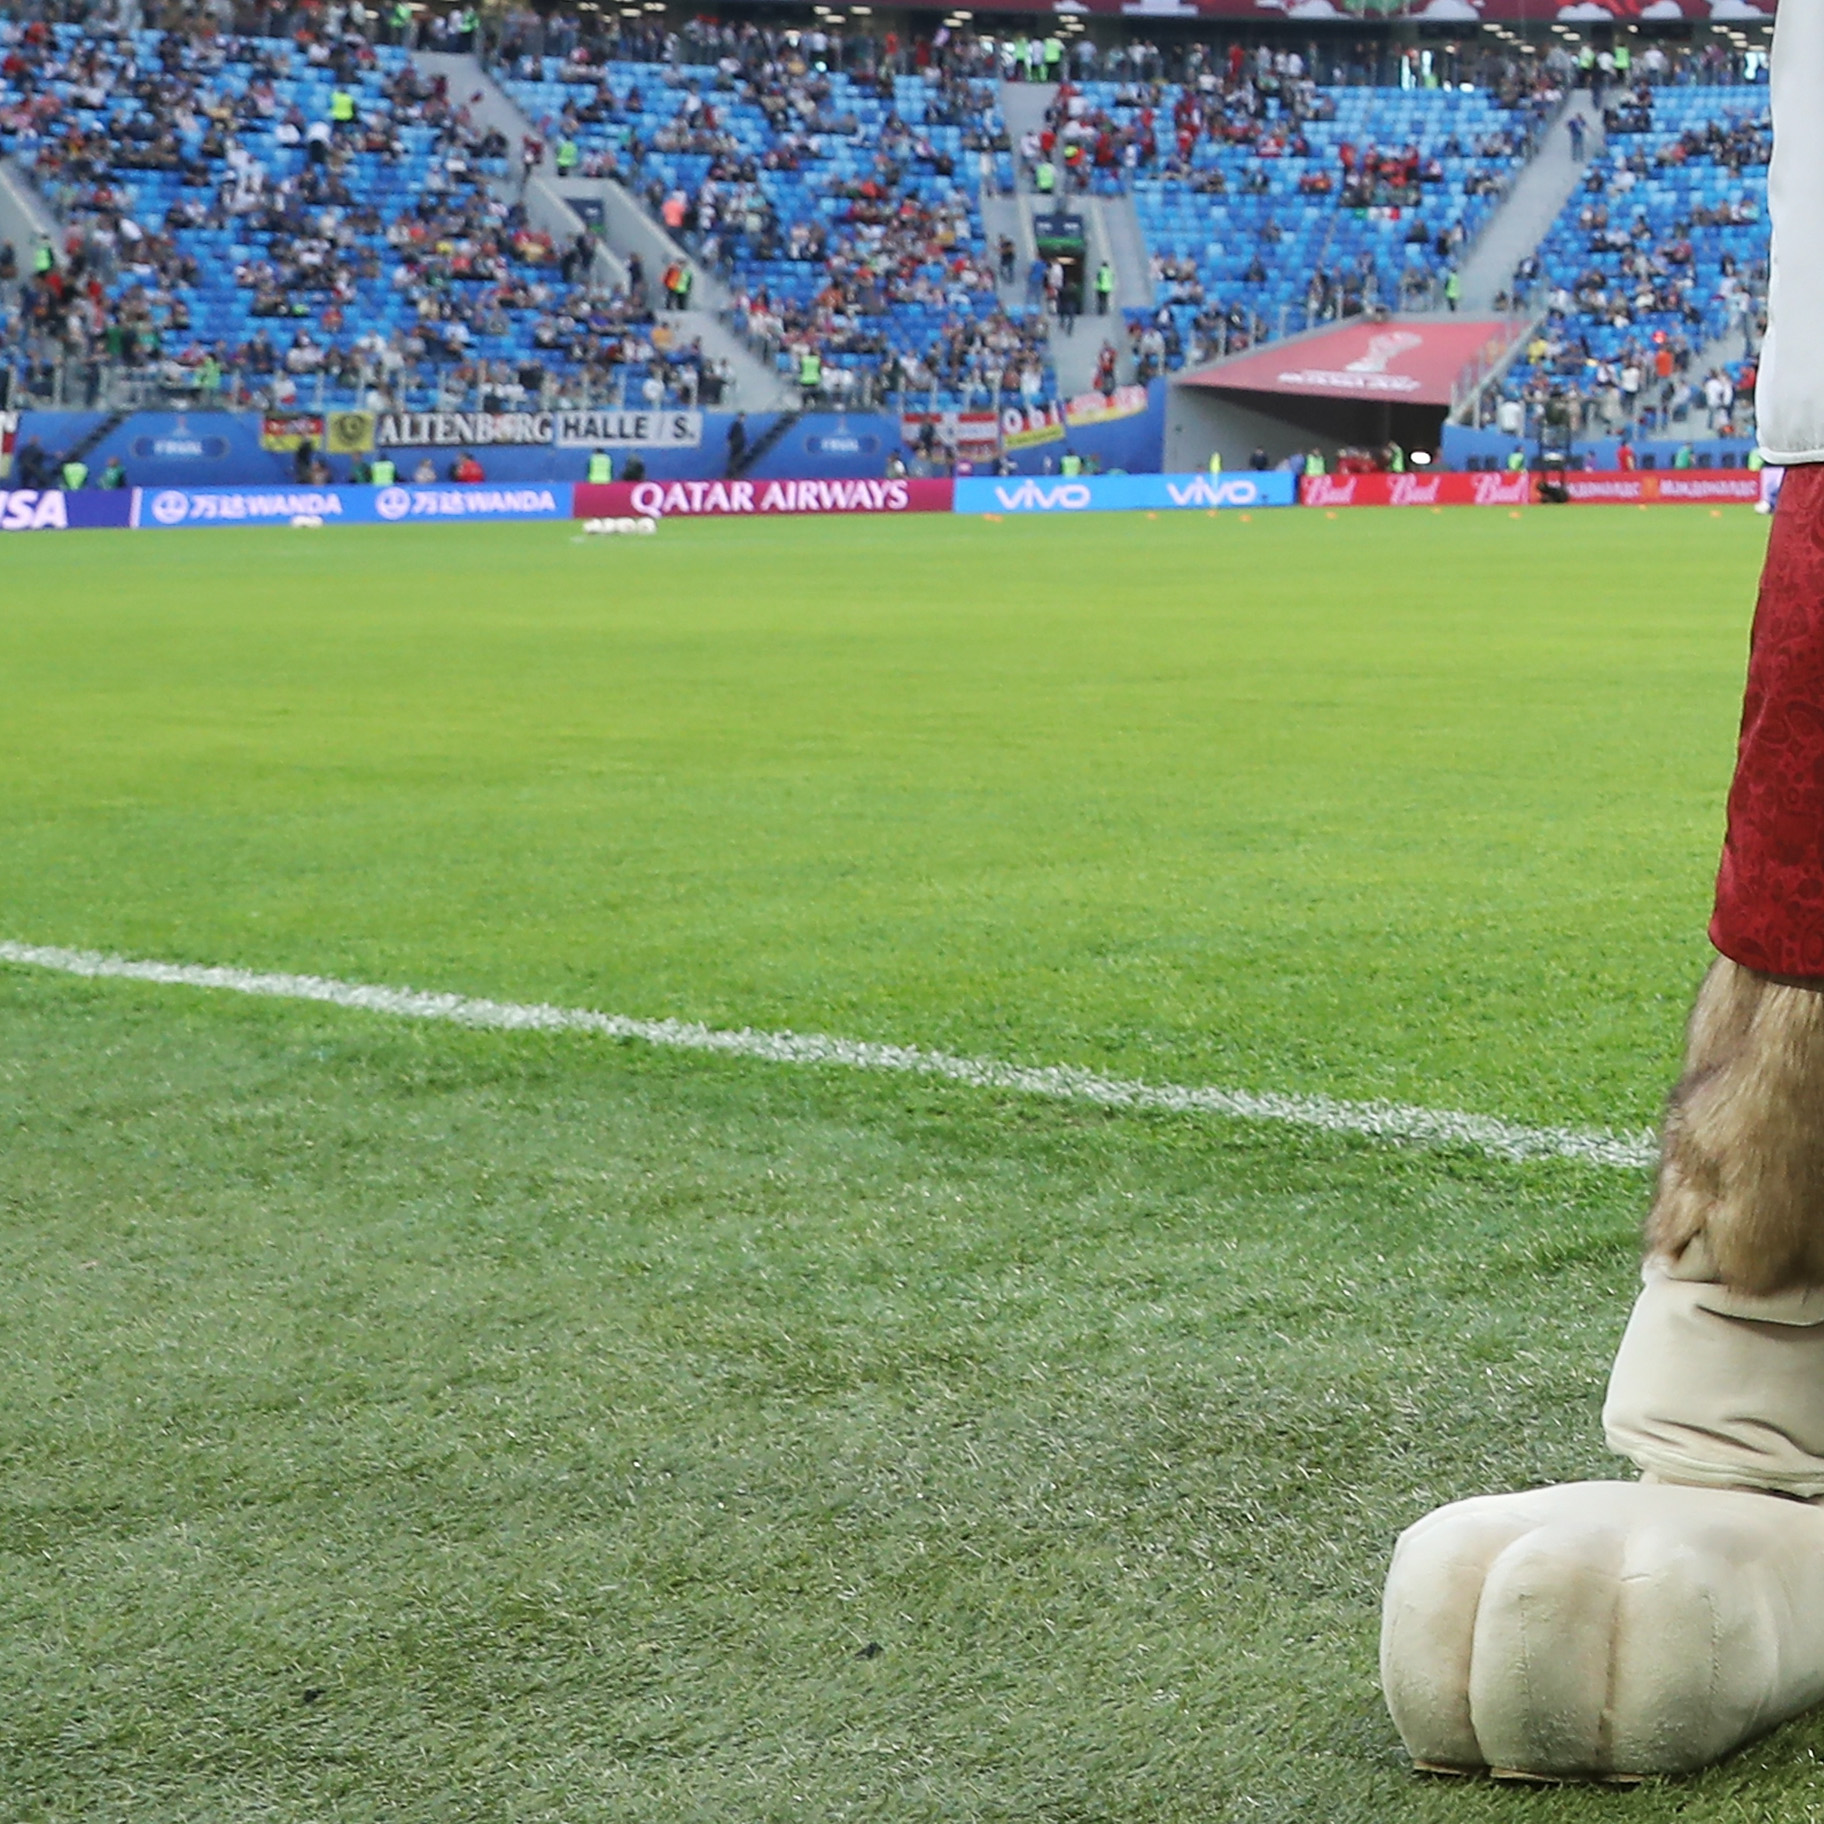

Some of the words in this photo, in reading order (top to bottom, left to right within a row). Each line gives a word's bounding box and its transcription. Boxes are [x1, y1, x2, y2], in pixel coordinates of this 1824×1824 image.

[564, 415, 647, 439] HALLE
[630, 480, 755, 518] QATAR
[761, 479, 909, 511] AIRWAYS
[995, 478, 1091, 509] vivo
[1167, 476, 1257, 506] vivo
